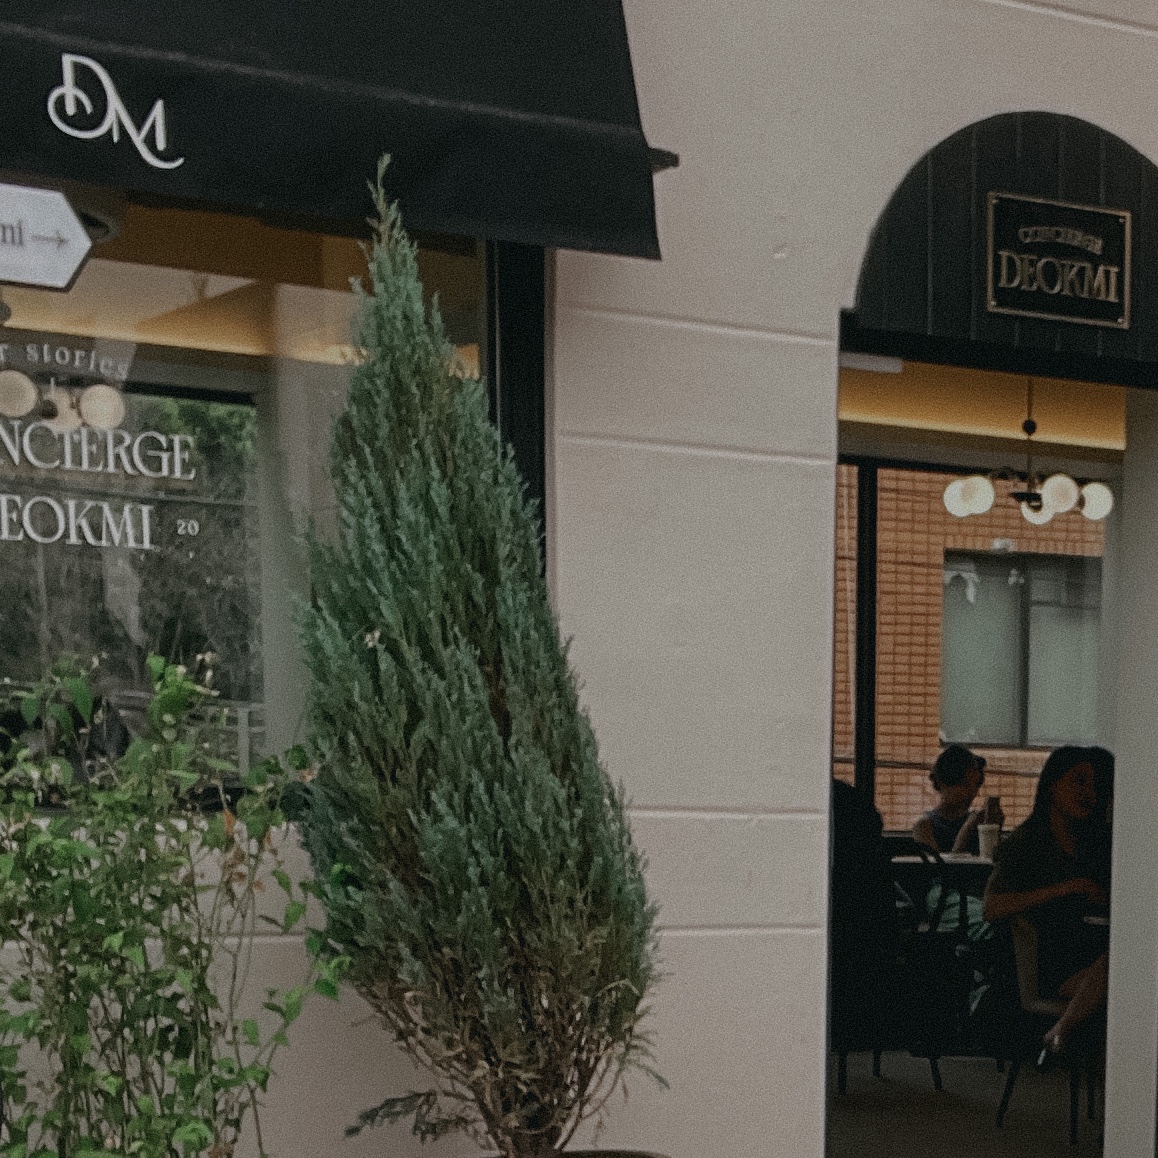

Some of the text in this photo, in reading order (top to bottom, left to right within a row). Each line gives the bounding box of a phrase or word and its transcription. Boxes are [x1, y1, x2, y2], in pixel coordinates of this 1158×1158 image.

[997, 250, 1119, 303] DEOKMI
[25, 342, 128, 381] stories
[176, 518, 200, 537] 20
